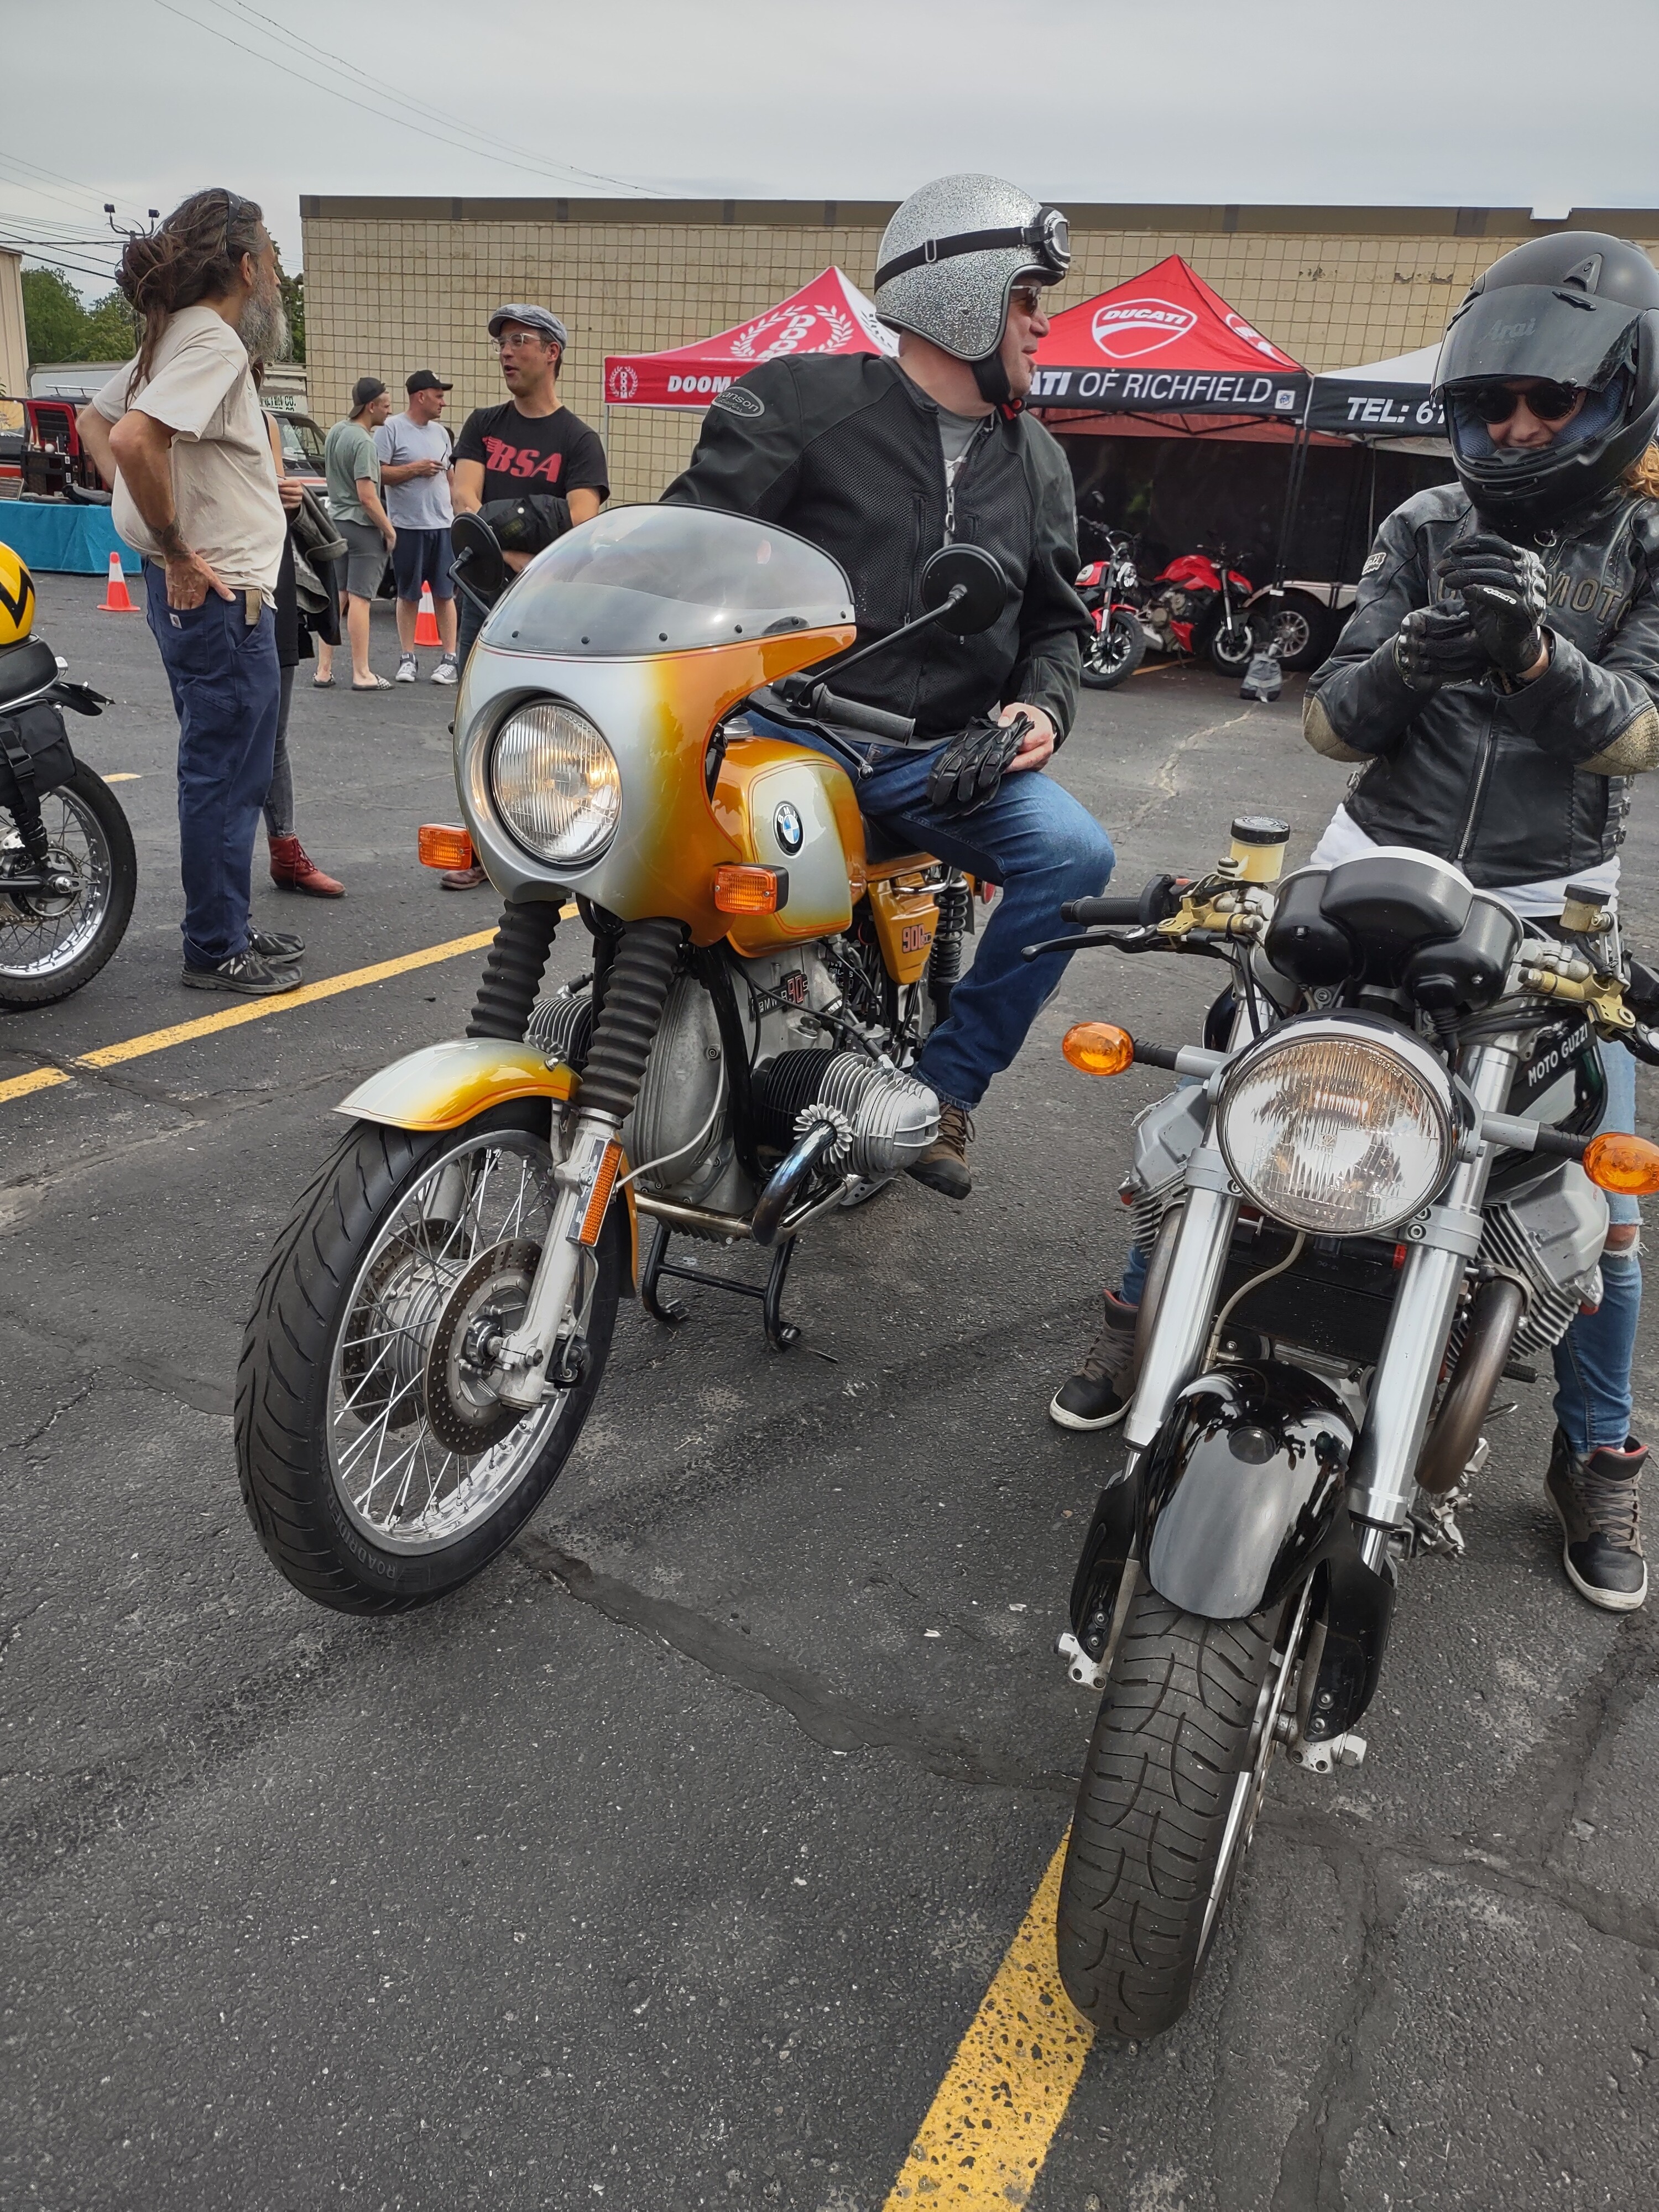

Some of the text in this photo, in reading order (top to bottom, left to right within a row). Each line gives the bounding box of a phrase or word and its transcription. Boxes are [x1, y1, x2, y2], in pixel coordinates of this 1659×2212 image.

[1102, 309, 1188, 325] DUCATI
[1079, 372, 1120, 397] OF
[1121, 373, 1272, 403] RICHFIELD
[718, 392, 759, 413] anson
[1347, 397, 1410, 423] TEL:
[485, 437, 562, 483] BSA
[1528, 1022, 1588, 1087] MOTO GUZZI
